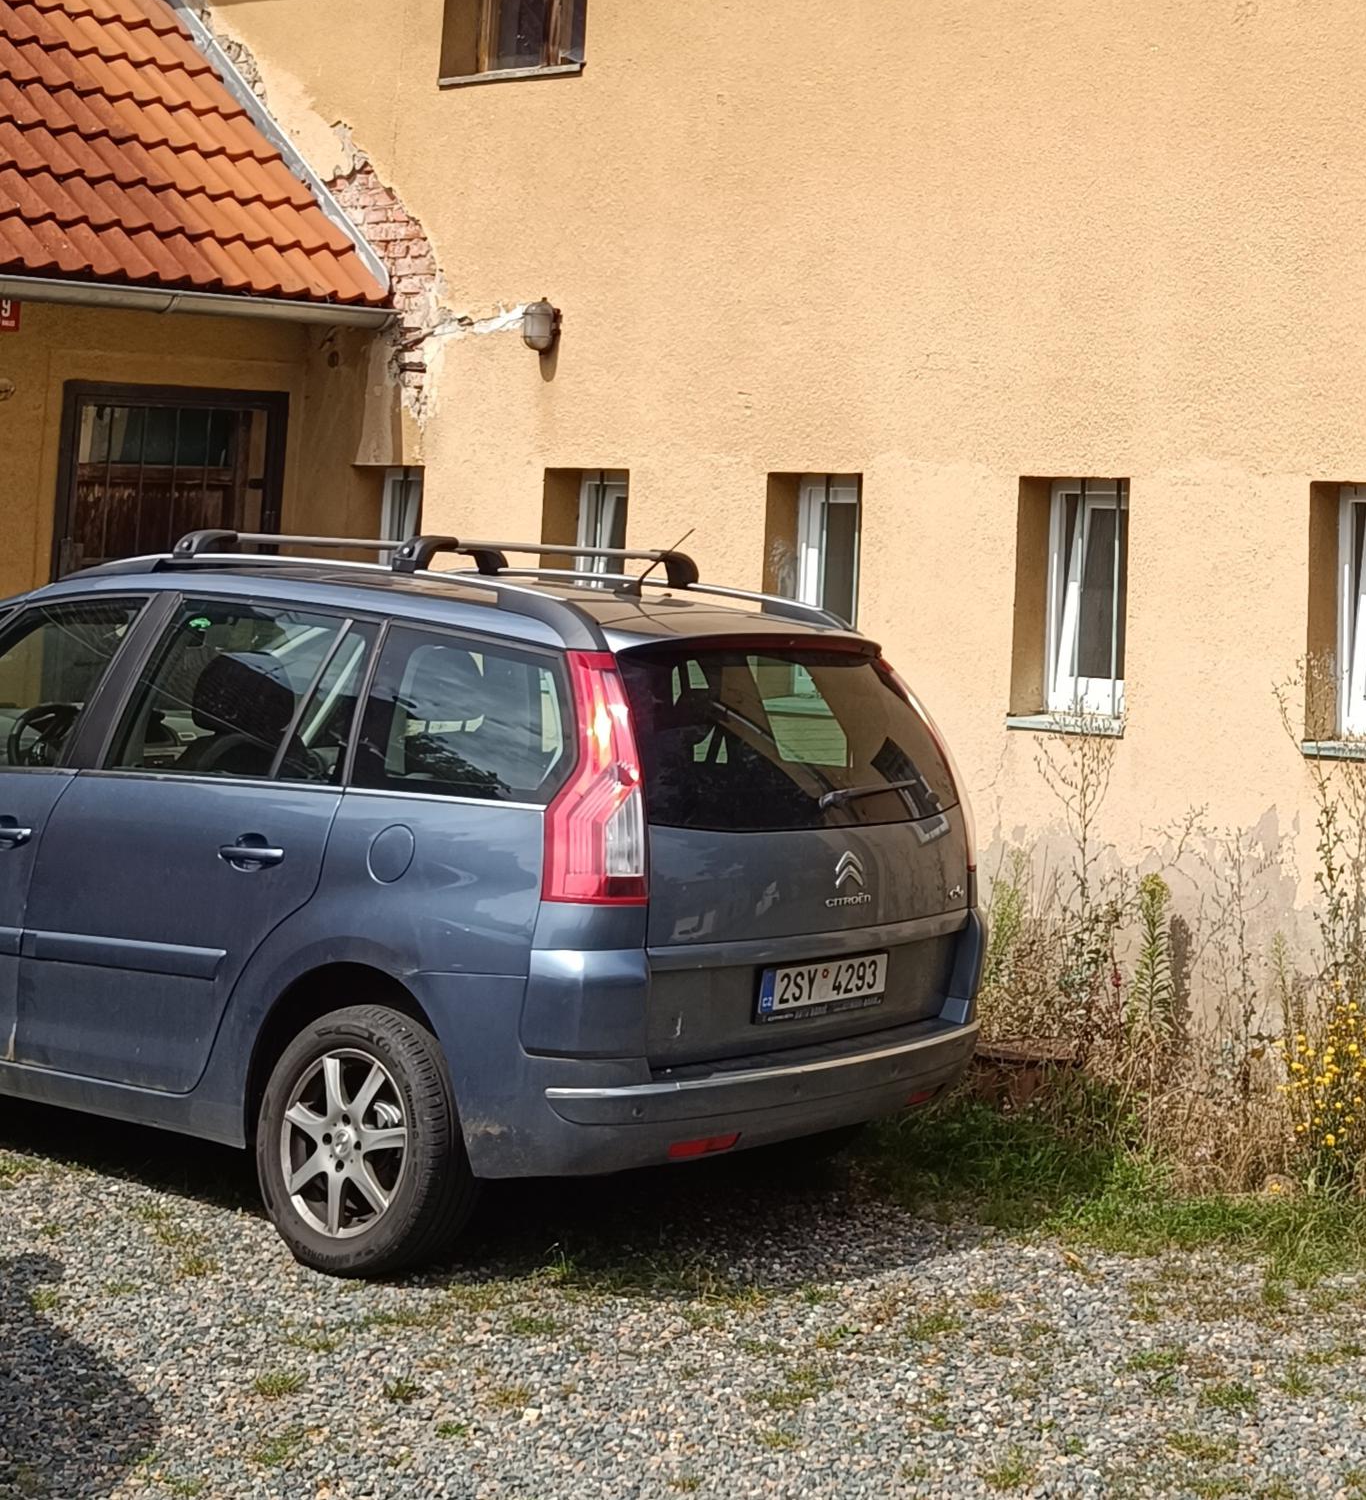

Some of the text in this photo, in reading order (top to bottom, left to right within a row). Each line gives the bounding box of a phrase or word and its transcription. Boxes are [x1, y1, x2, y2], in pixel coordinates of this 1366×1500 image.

[778, 967, 818, 1005] 2SY
[832, 959, 878, 996] 4293
[762, 996, 773, 1008] CZ
